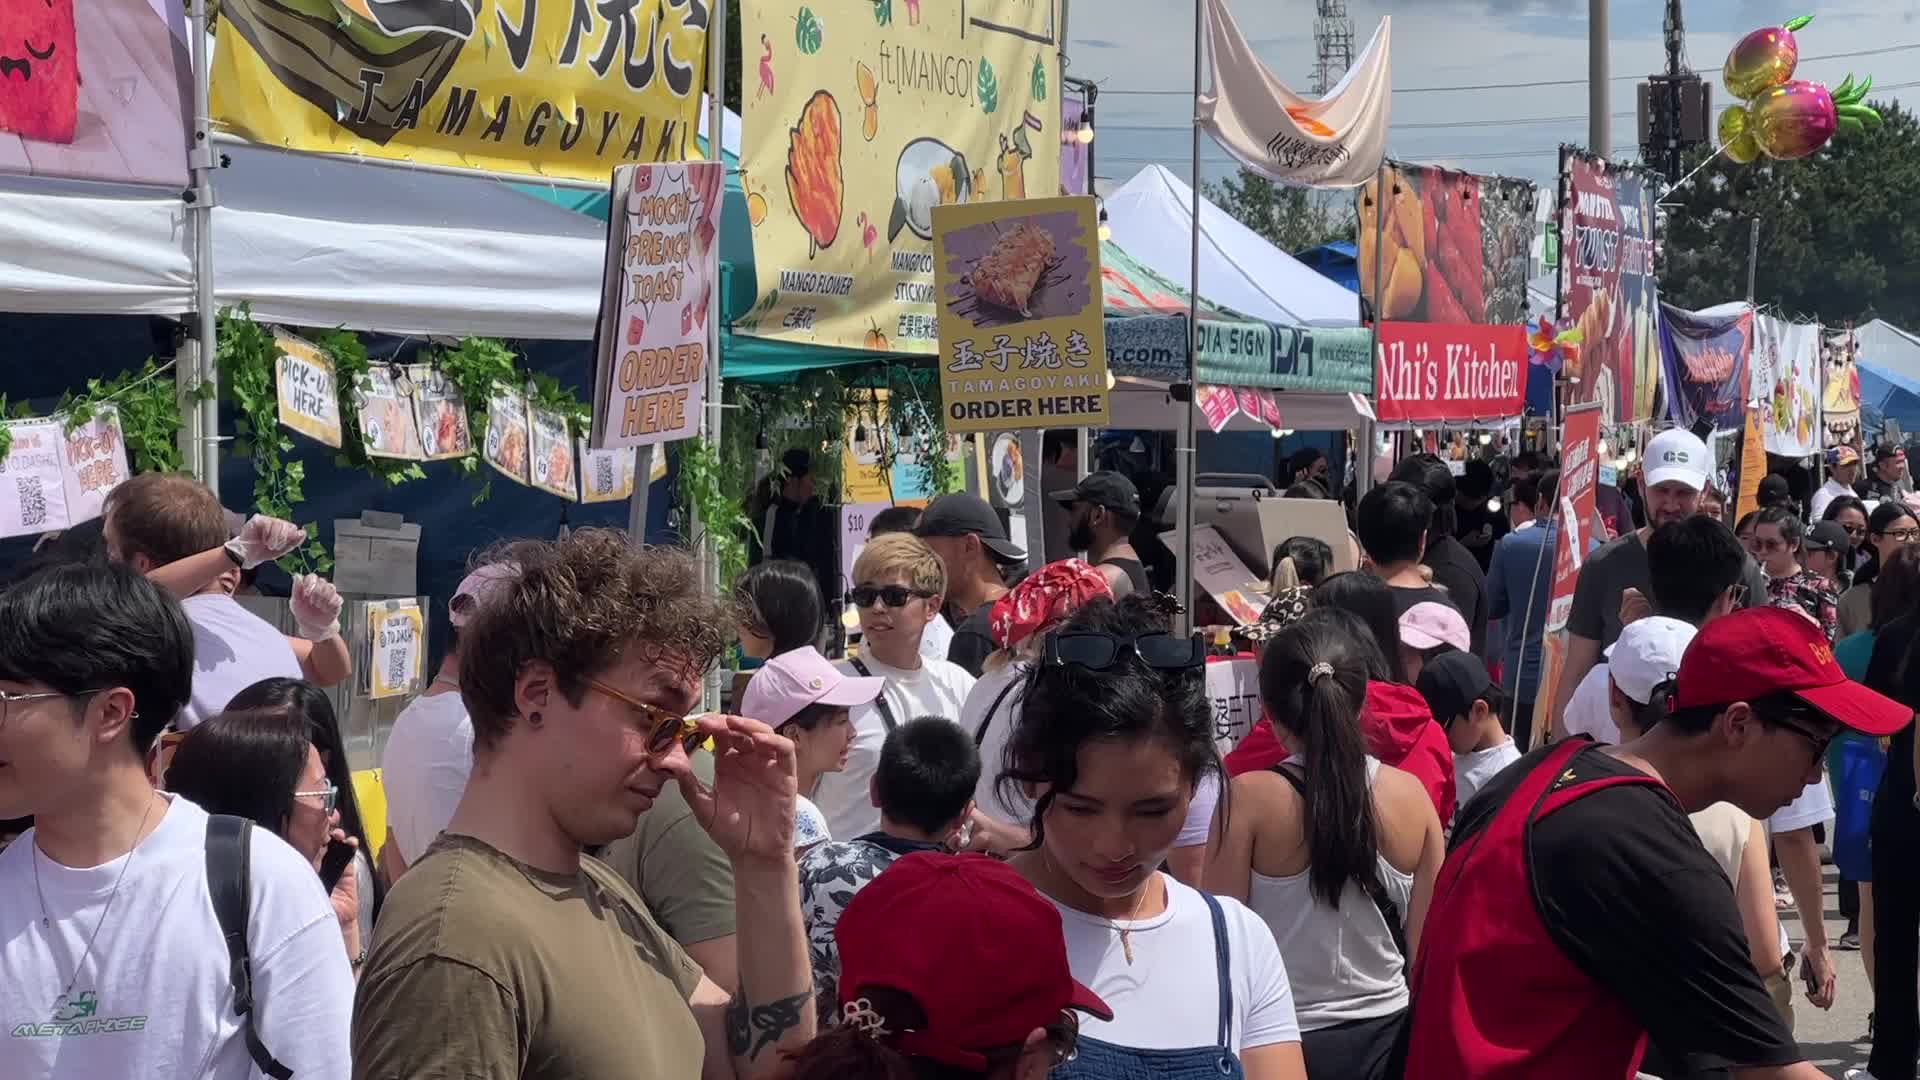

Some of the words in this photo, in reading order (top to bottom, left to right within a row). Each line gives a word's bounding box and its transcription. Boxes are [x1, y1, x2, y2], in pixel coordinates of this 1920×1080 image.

[357, 68, 690, 162] TAMAGOYAKI
[638, 187, 692, 226] MOCHI
[628, 230, 690, 267] FRENCH
[891, 251, 919, 272] MANGO
[632, 266, 685, 305] TOAST
[779, 271, 817, 293] MANGO
[818, 275, 854, 296] FLOWER
[895, 282, 927, 302] STICKY
[948, 329, 1092, 373] 玉子焼き
[1230, 330, 1265, 356] SIGN
[619, 343, 704, 393] ORDER
[949, 373, 1102, 393] TAMAGOYAKI
[1378, 341, 1438, 400] Nhi's
[1444, 342, 1520, 400] Kitchen
[292, 386, 325, 417] HERE
[620, 389, 689, 439] HERE
[950, 400, 1033, 420] ORDER
[1038, 395, 1103, 415] HERE
[1663, 450, 1689, 463] GO
[847, 513, 864, 532] $10
